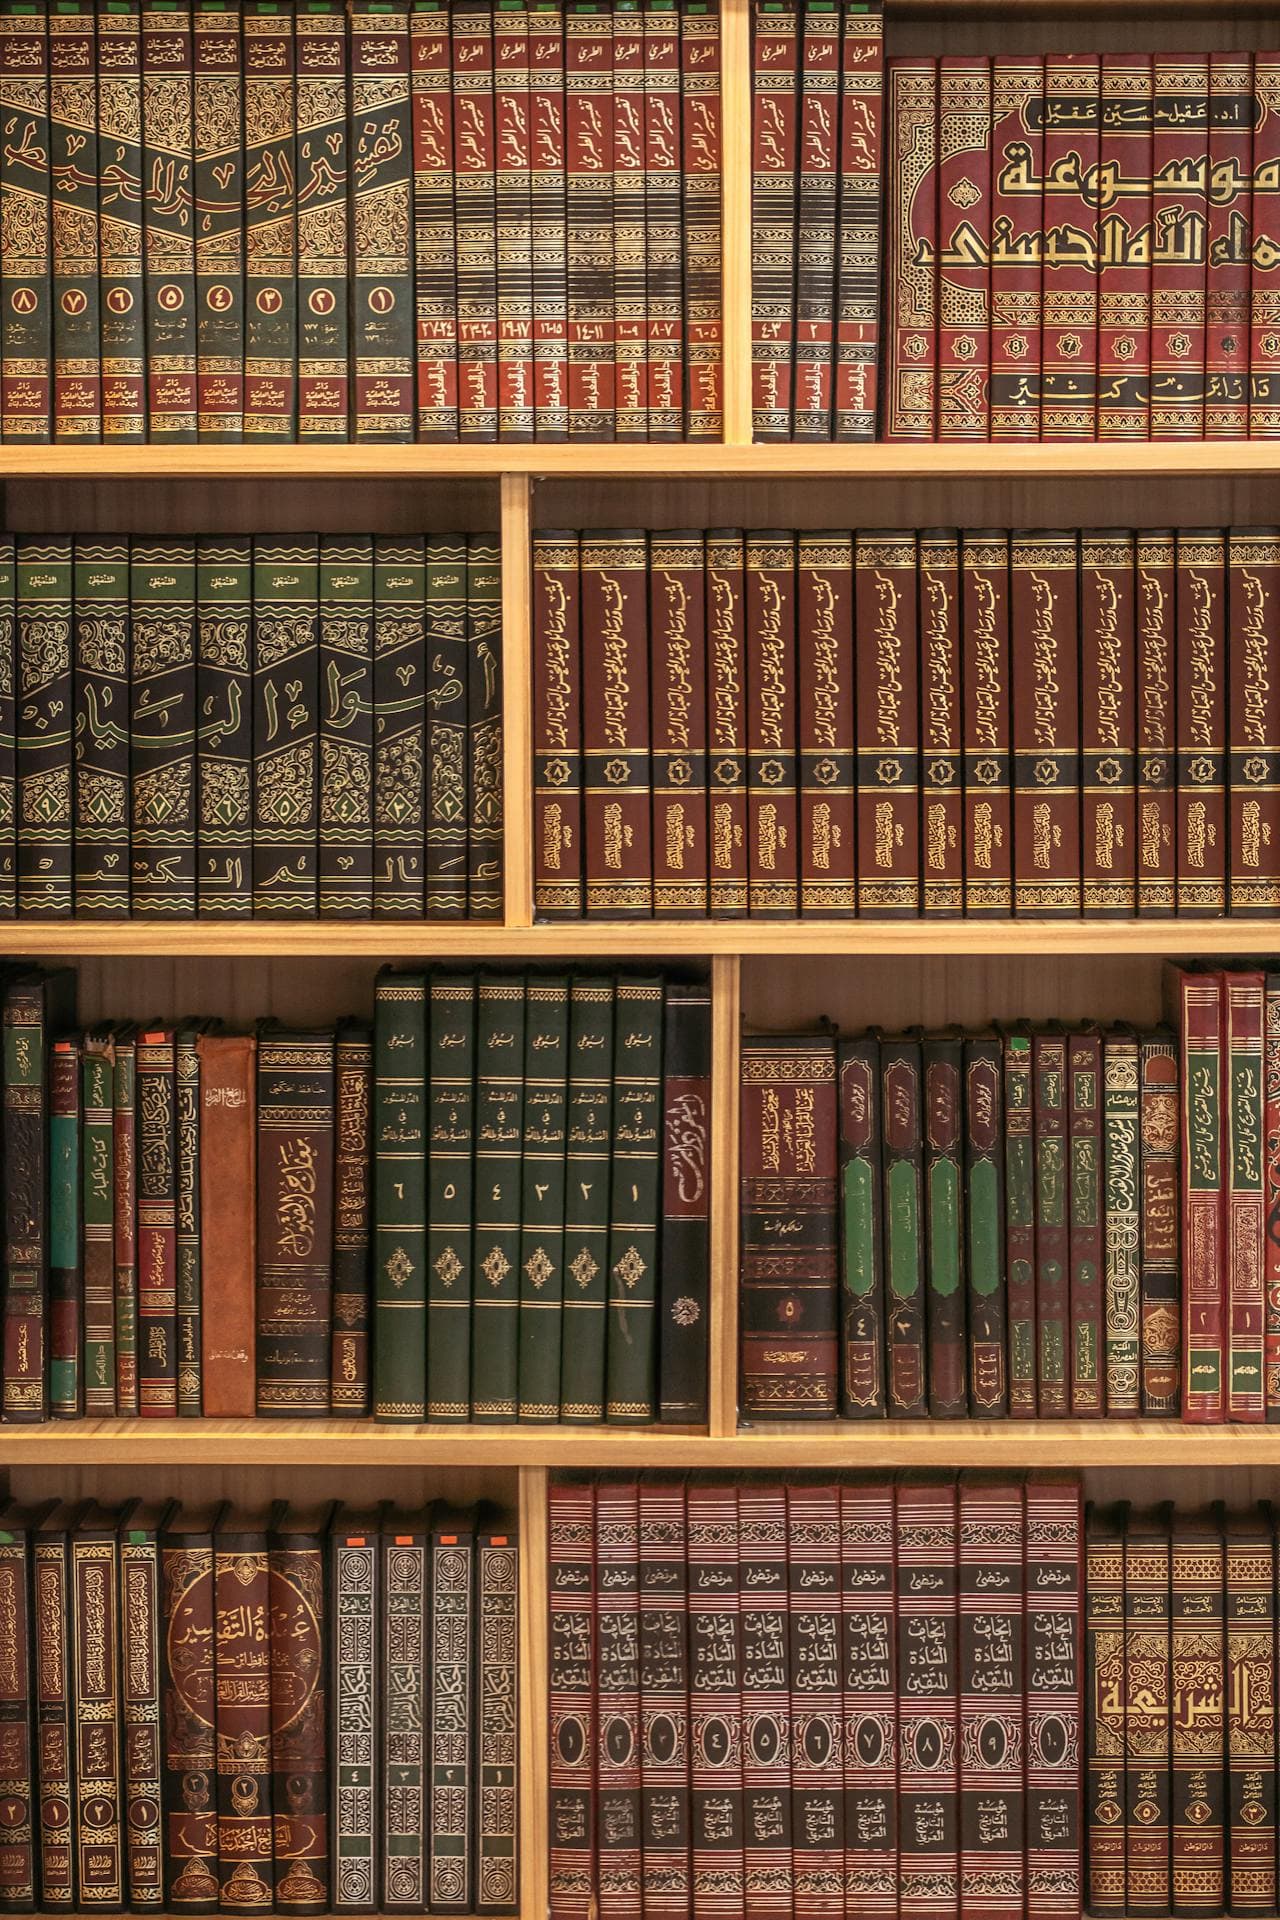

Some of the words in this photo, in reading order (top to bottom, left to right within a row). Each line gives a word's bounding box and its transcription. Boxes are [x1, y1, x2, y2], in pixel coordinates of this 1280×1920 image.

[418, 44, 442, 60] الطبري
[501, 43, 525, 59] الطبري
[536, 43, 559, 59] الطبري
[578, 46, 602, 62] الطبري
[690, 47, 714, 63] الطبري
[762, 45, 786, 61] الطبري
[853, 46, 877, 62] الطبري
[1037, 103, 1097, 124] عقيل
[1102, 104, 1168, 126] حسين
[1169, 102, 1206, 123] عقيل
[4, 117, 175, 205] المحيط
[297, 119, 402, 202] تفسير
[914, 216, 1126, 271] الحسنى
[18, 293, 31, 309] ٨
[66, 294, 81, 310] ٧
[114, 292, 126, 309] ٦
[165, 290, 178, 306] ٥
[215, 291, 224, 306] ٤
[264, 292, 276, 309] ٣
[317, 294, 326, 309] ٢
[379, 292, 386, 309] ١
[810, 323, 818, 339] ٢
[859, 324, 864, 340] ١
[910, 342, 922, 353] 10
[960, 341, 969, 354] 9
[1012, 340, 1020, 352] 8
[1066, 340, 1074, 351] 7
[1120, 342, 1129, 354] 6
[1174, 339, 1183, 351] 5
[1267, 339, 1276, 351] 3
[1008, 376, 1128, 405] كثير
[553, 765, 563, 778] ٨
[1041, 766, 1051, 778] ٧
[41, 797, 52, 816] ٩
[96, 799, 108, 814] ٨
[153, 801, 165, 817] ٧
[222, 800, 232, 817] ٦
[279, 800, 290, 817] ٥
[341, 800, 349, 817] ٤
[394, 802, 404, 818] ٣
[445, 800, 454, 815] ٢
[486, 800, 491, 817] ١
[1106, 1094, 1129, 1106] هشام
[634, 1107, 643, 1122] في
[393, 1183, 404, 1200] ٦
[444, 1183, 456, 1199] ٥
[492, 1183, 502, 1201] ٤
[535, 1184, 550, 1201] ٣
[580, 1182, 593, 1200] ٢
[631, 1184, 638, 1202] ١
[1200, 1311, 1207, 1326] ٢
[1245, 1311, 1251, 1328] ١
[174, 1605, 253, 1646] التفسير
[909, 1646, 948, 1665] السادة
[1035, 1642, 1074, 1661] السادة
[907, 1667, 949, 1695] المتقين
[1032, 1664, 1074, 1690] المتقين
[1101, 1663, 1250, 1729] الشريعة
[568, 1735, 574, 1749] ١
[711, 1733, 722, 1749] ٤
[760, 1733, 770, 1747] ٥
[813, 1735, 822, 1750] ٦
[863, 1734, 875, 1748] ٧
[921, 1737, 933, 1752] ٨
[988, 1736, 997, 1751] ٩
[496, 1770, 502, 1784] ١
[7, 1805, 17, 1820] ٢
[52, 1805, 59, 1821] ١
[94, 1805, 104, 1821] ٢
[140, 1805, 148, 1822] ١
[1100, 1806, 1113, 1818] ٦
[1142, 1807, 1151, 1819] ٥
[1194, 1805, 1202, 1819] ٤
[1248, 1807, 1258, 1820] ٣
